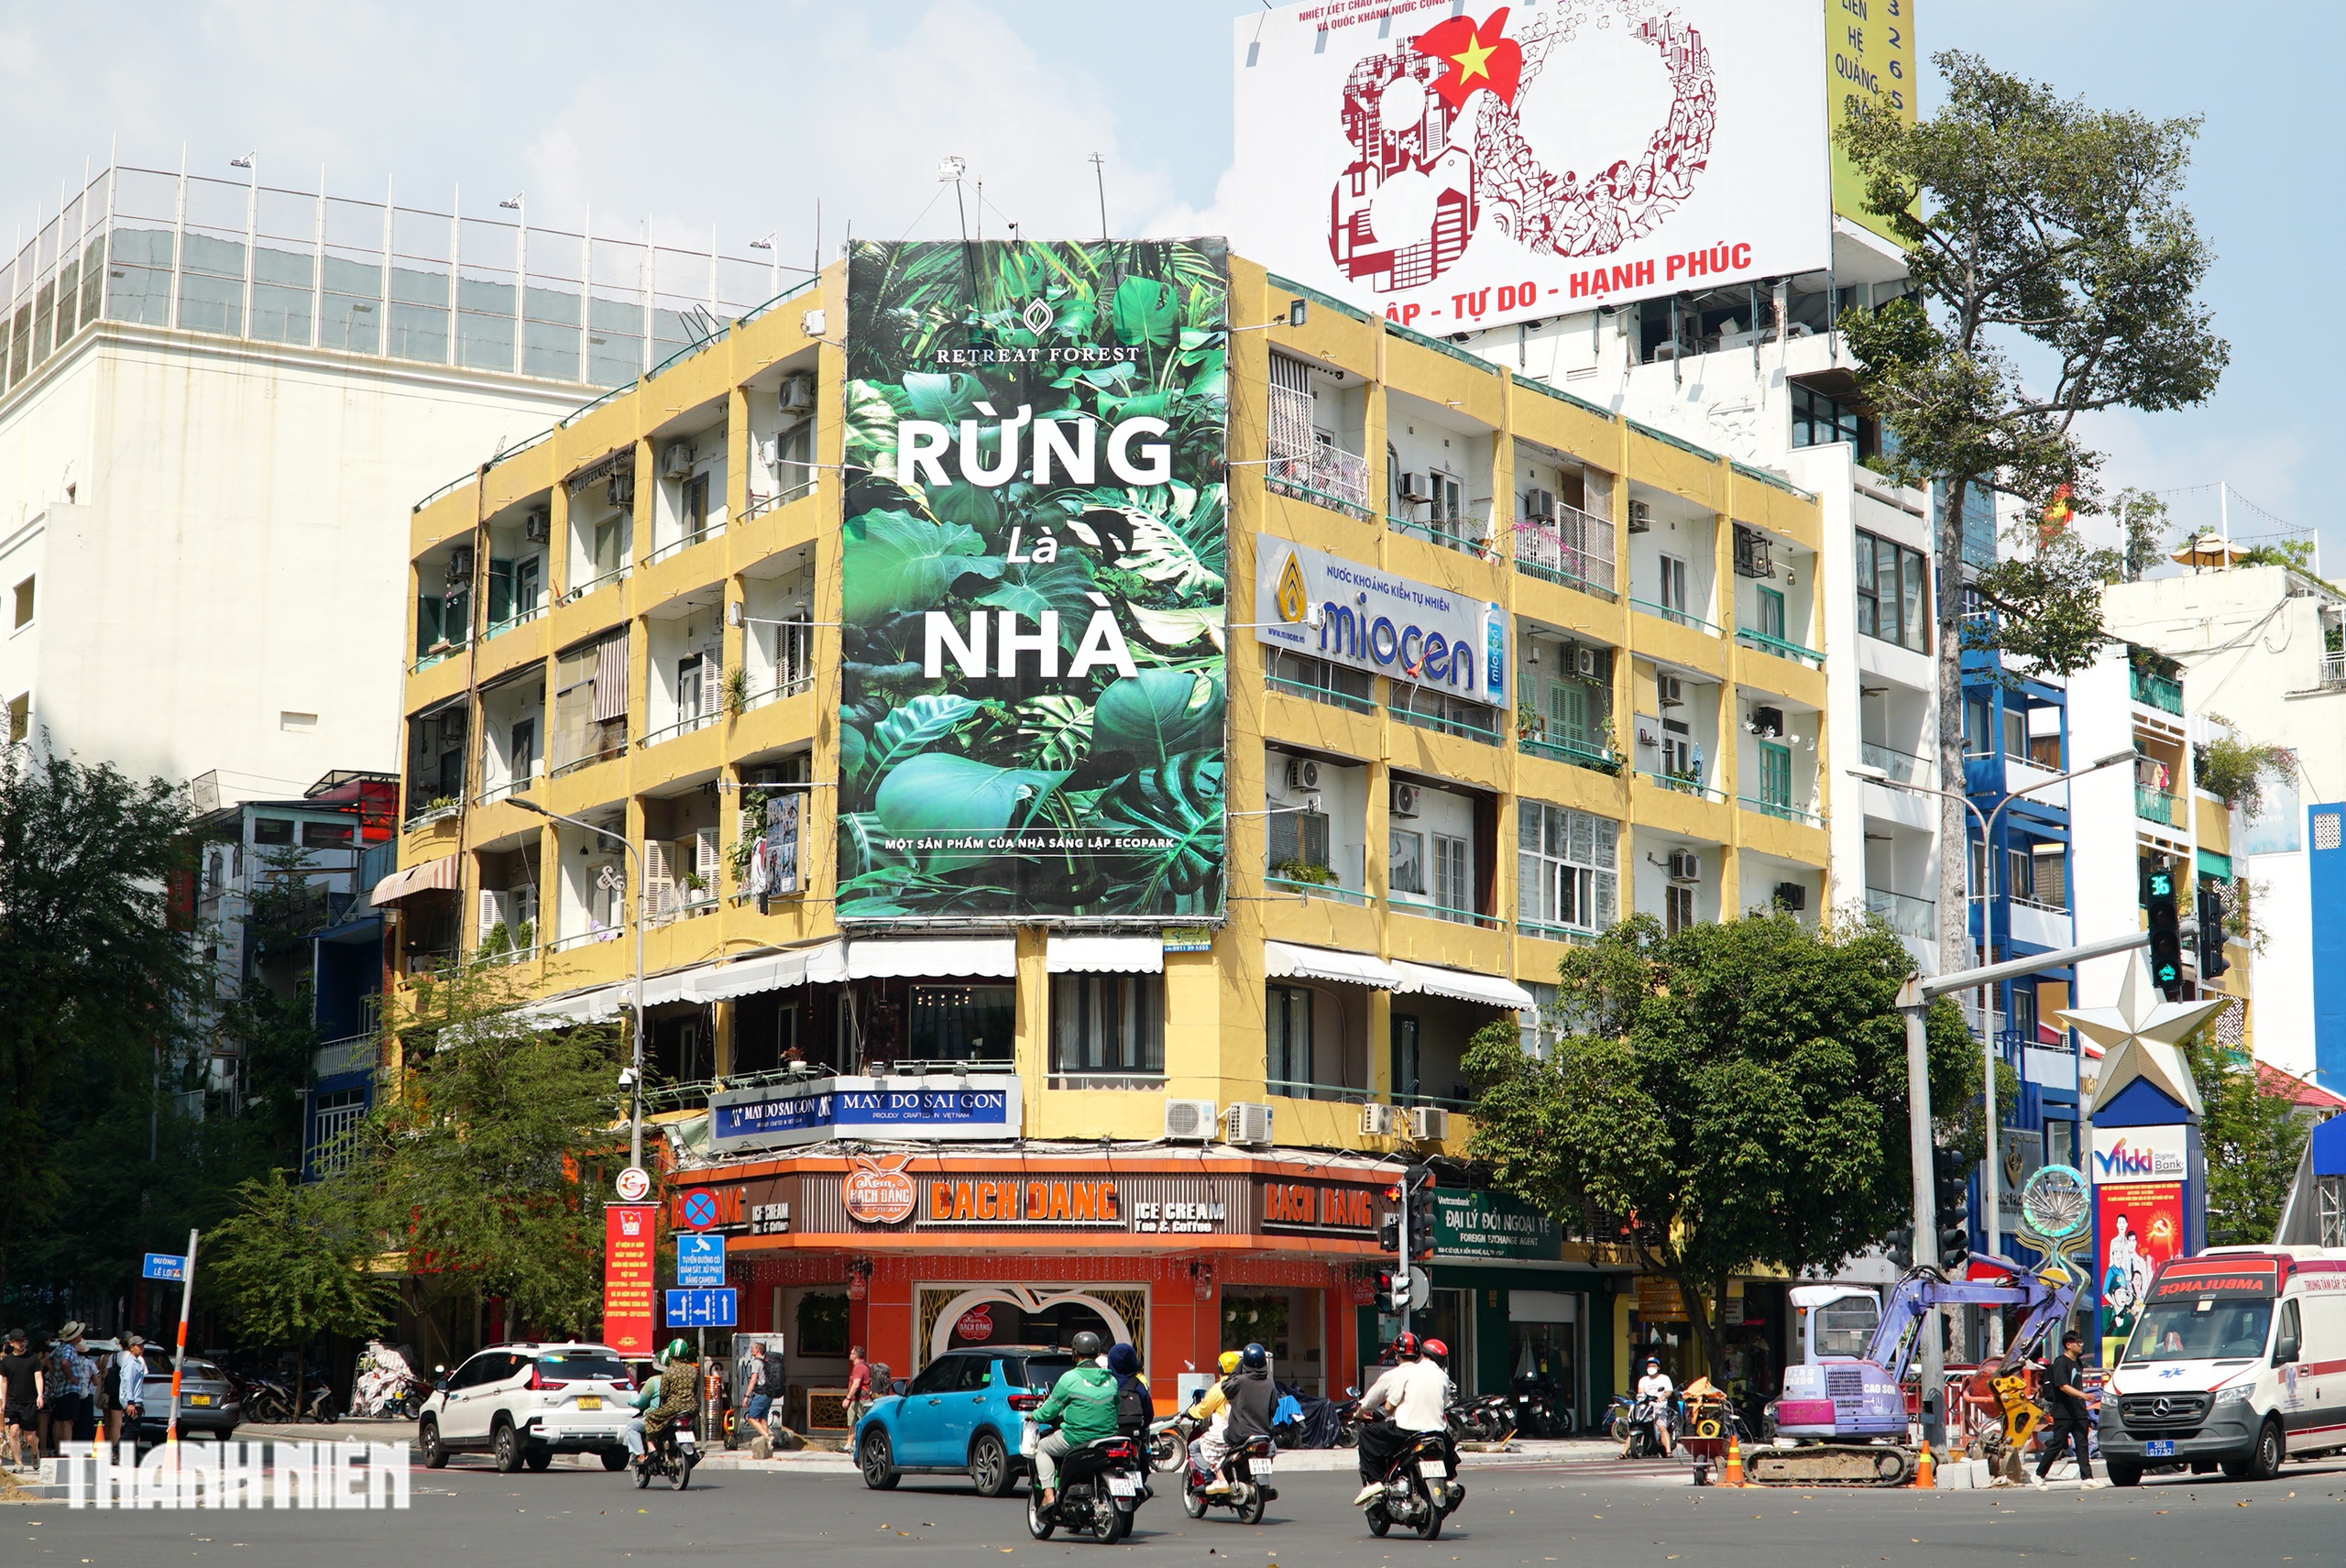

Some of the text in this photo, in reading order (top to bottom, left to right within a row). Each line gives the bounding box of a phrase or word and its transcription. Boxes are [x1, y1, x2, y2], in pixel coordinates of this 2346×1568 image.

[1299, 6, 1325, 22] NHIỆT
[1328, 1, 1345, 16] LIỆT
[1317, 20, 1329, 33] VÀ
[1331, 13, 1355, 29] QUỐC
[1358, 7, 1389, 24] KHÁNH
[1391, 0, 1417, 16] NƯỚC
[1847, 25, 1864, 59] HỆ
[1835, 52, 1879, 94] QUẢNG
[1452, 286, 1491, 322] TỰ
[1498, 280, 1536, 312] DO
[1571, 260, 1653, 300] HẠNH
[1666, 241, 1752, 280] PHÚC
[937, 347, 1139, 363] RETREAT FOREST
[896, 401, 1171, 488] RỪNG
[1006, 526, 1058, 565] Là
[1327, 565, 1353, 585] NƯỚC
[1353, 572, 1389, 595] KHOÁNG
[1412, 591, 1424, 608] TỰ
[1425, 597, 1451, 613] NHIÊN
[923, 592, 1139, 679] NHÀ
[1317, 591, 1474, 691] miocen
[884, 839, 915, 850] MỘT
[917, 836, 944, 850] SẢN
[988, 836, 1014, 849] CỦA
[1017, 836, 1045, 849] NHÀ
[1048, 836, 1084, 849] SÁNG
[1088, 837, 1111, 850] LẬP
[1114, 837, 1175, 849] ECOPARK
[744, 1099, 815, 1120] MAY DO SAI GON
[843, 1093, 1003, 1109] MAY DO SAI GON
[872, 1112, 900, 1120] PROUDLY
[903, 1112, 931, 1120] CRAFTED
[2094, 1137, 2176, 1174] Vikki Digital
[2154, 1159, 2183, 1170] Bank
[930, 1182, 1117, 1221] BACH DANG
[1265, 1182, 1316, 1223] BACH
[1321, 1187, 1373, 1228] DANG
[1438, 1195, 1470, 1206] Vietcombank
[1135, 1202, 1225, 1221] ICE CREAM
[1445, 1207, 1551, 1236] ĐẠI LÝ ĐỔI NGOẠI TỆ
[1135, 1222, 1212, 1234] Tea & Coffee
[1460, 1233, 1539, 1246] FOREIGN EXCHANGE AGENT
[154, 1266, 172, 1278] LÊ LỢI
[1864, 1384, 1880, 1394] CAO
[2154, 1441, 2167, 1449] 50A
